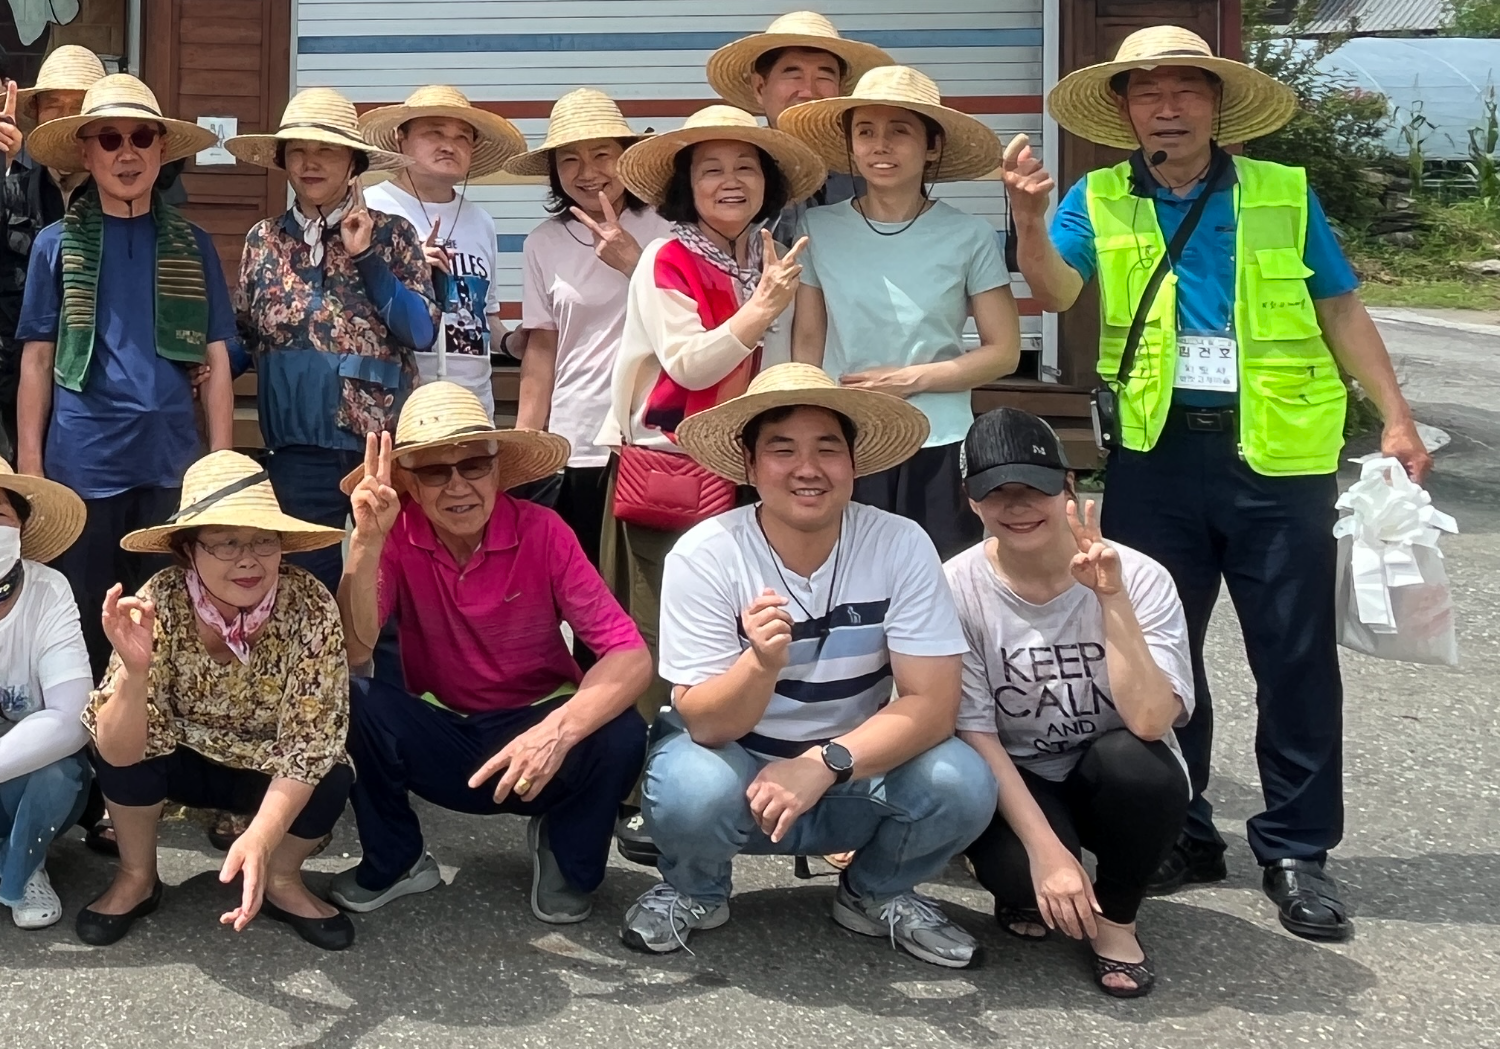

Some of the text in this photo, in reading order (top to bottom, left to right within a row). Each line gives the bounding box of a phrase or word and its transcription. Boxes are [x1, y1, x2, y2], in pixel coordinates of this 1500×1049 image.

[450, 252, 488, 281] TLES
[1001, 642, 1106, 682] KEEP
[1046, 719, 1096, 737] AND
